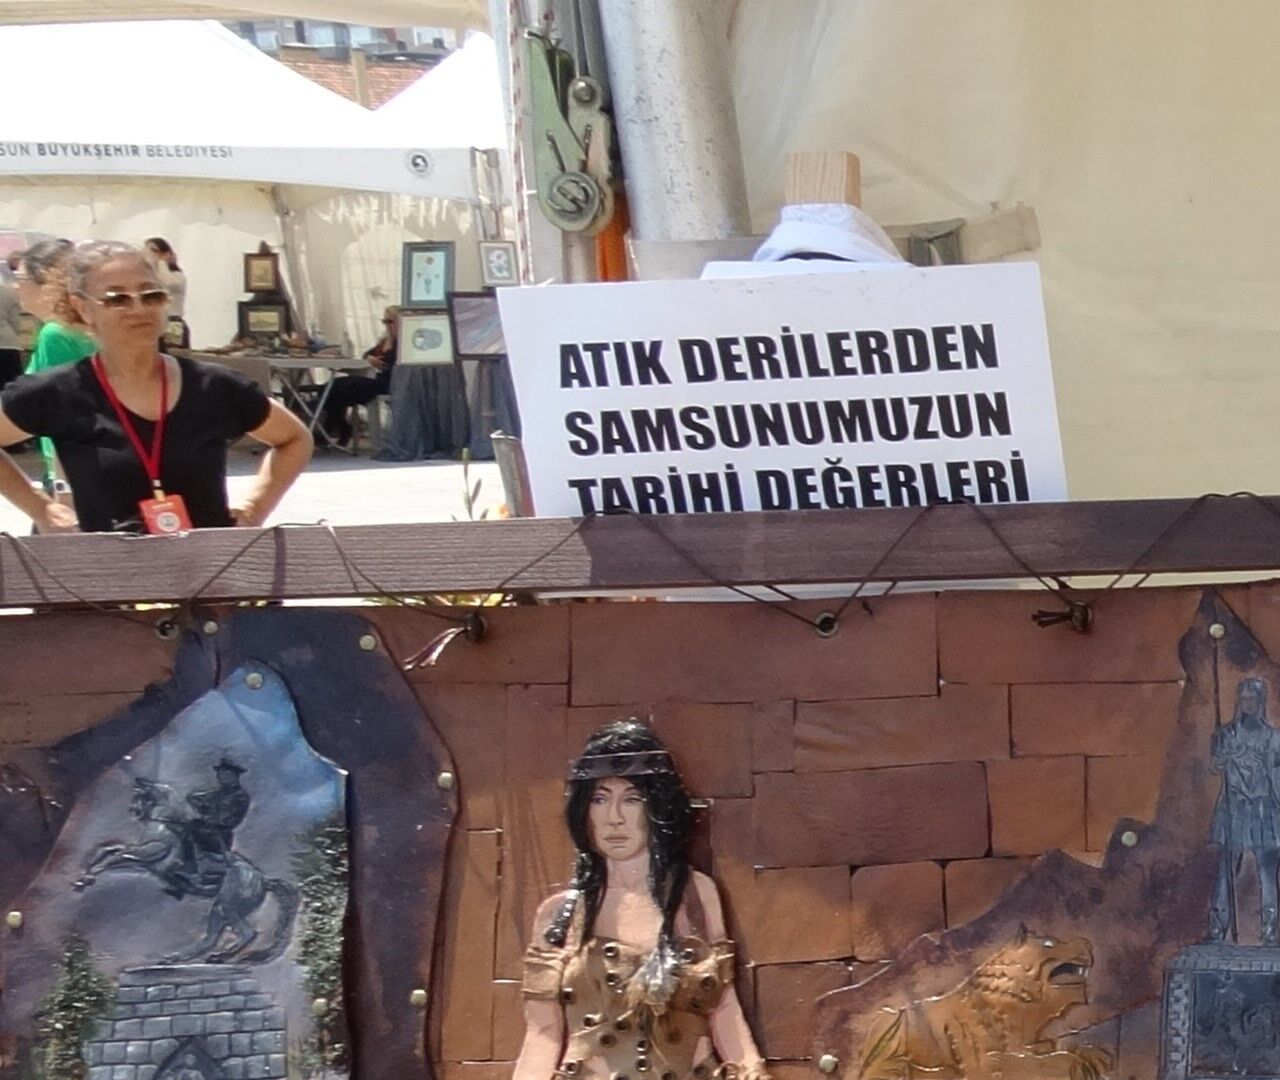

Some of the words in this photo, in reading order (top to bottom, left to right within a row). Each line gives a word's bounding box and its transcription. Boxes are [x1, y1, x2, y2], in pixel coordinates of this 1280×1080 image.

[559, 339, 670, 389] ATIK
[678, 323, 999, 383] DERİLERDEN
[564, 391, 1012, 457] SAMSUNUMUZUN
[567, 463, 744, 517] TARİHİ
[755, 449, 1031, 511] DEĞERLERİ
